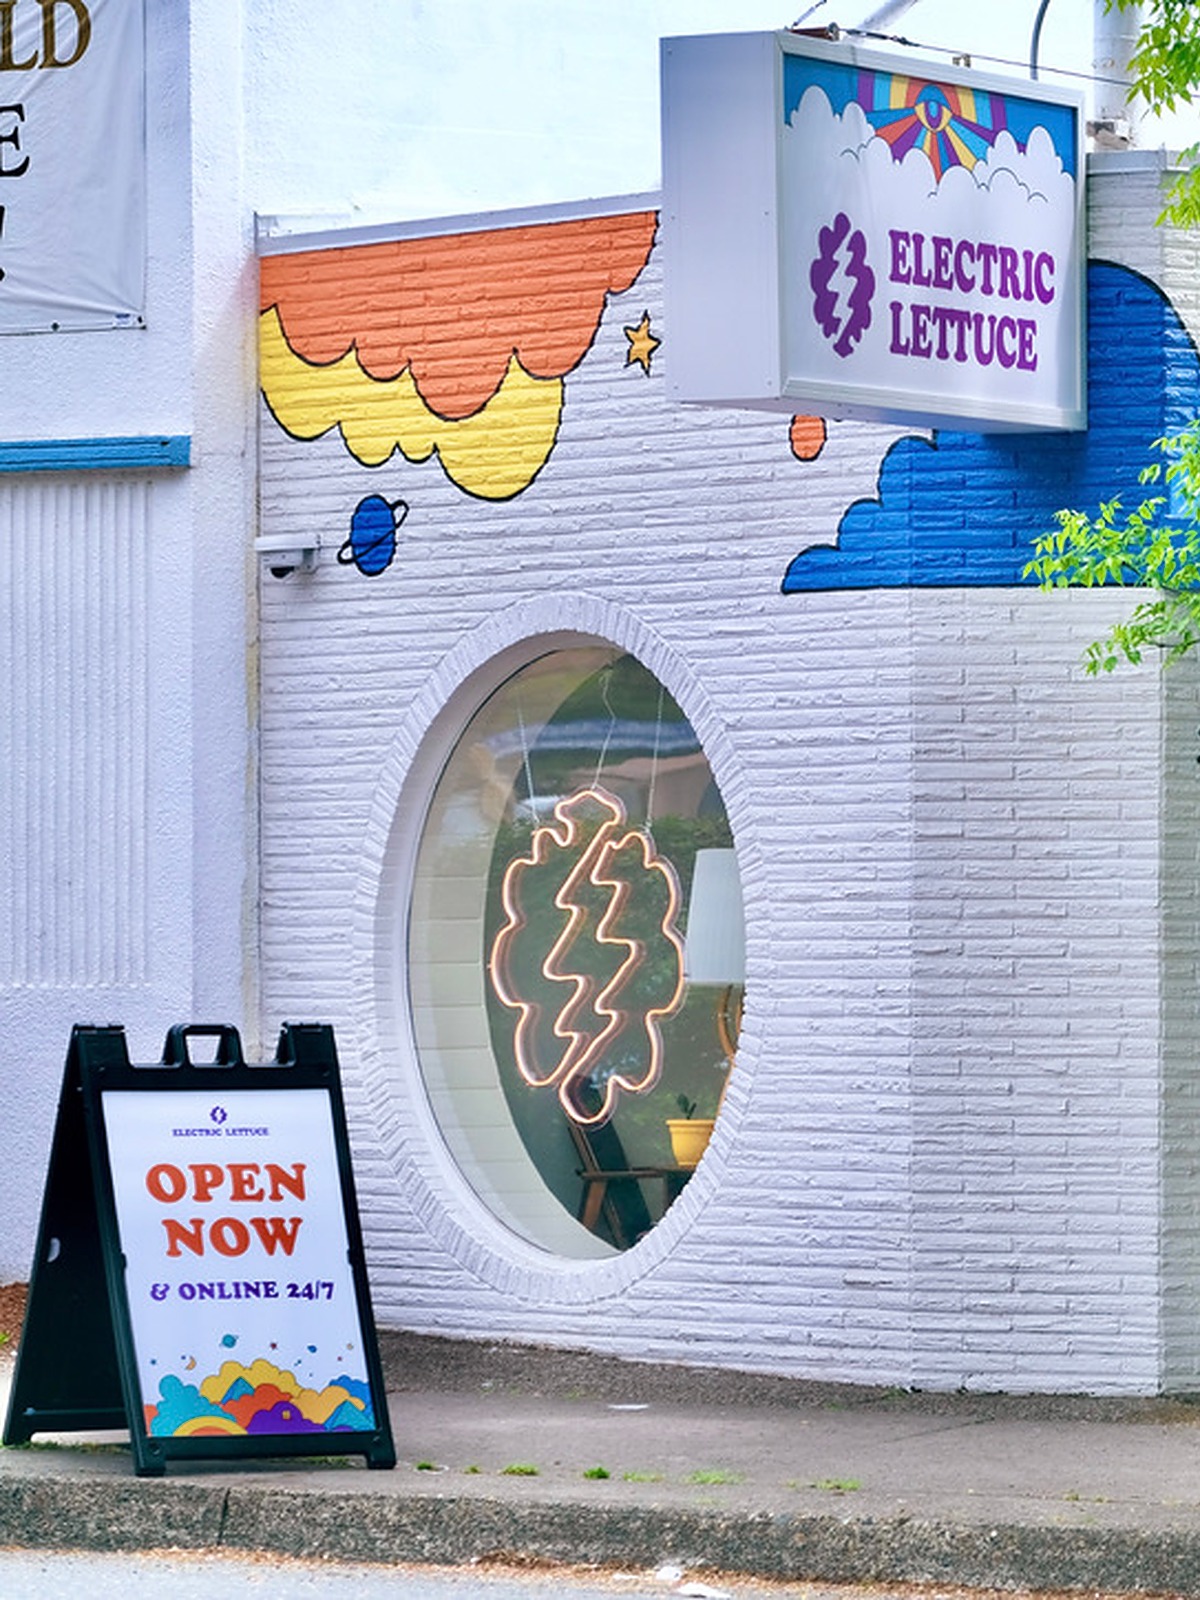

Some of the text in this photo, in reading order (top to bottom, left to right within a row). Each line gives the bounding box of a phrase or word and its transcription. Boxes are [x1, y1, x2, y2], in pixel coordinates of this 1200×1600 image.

[888, 229, 1056, 305] ELECTRIC
[889, 301, 1038, 372] LETTUCE
[172, 1127, 270, 1137] ELECTRIC LETTUCE
[145, 1163, 307, 1203] OPEN
[161, 1216, 303, 1257] NOW
[150, 1279, 335, 1301] & ONLINE 24/7
